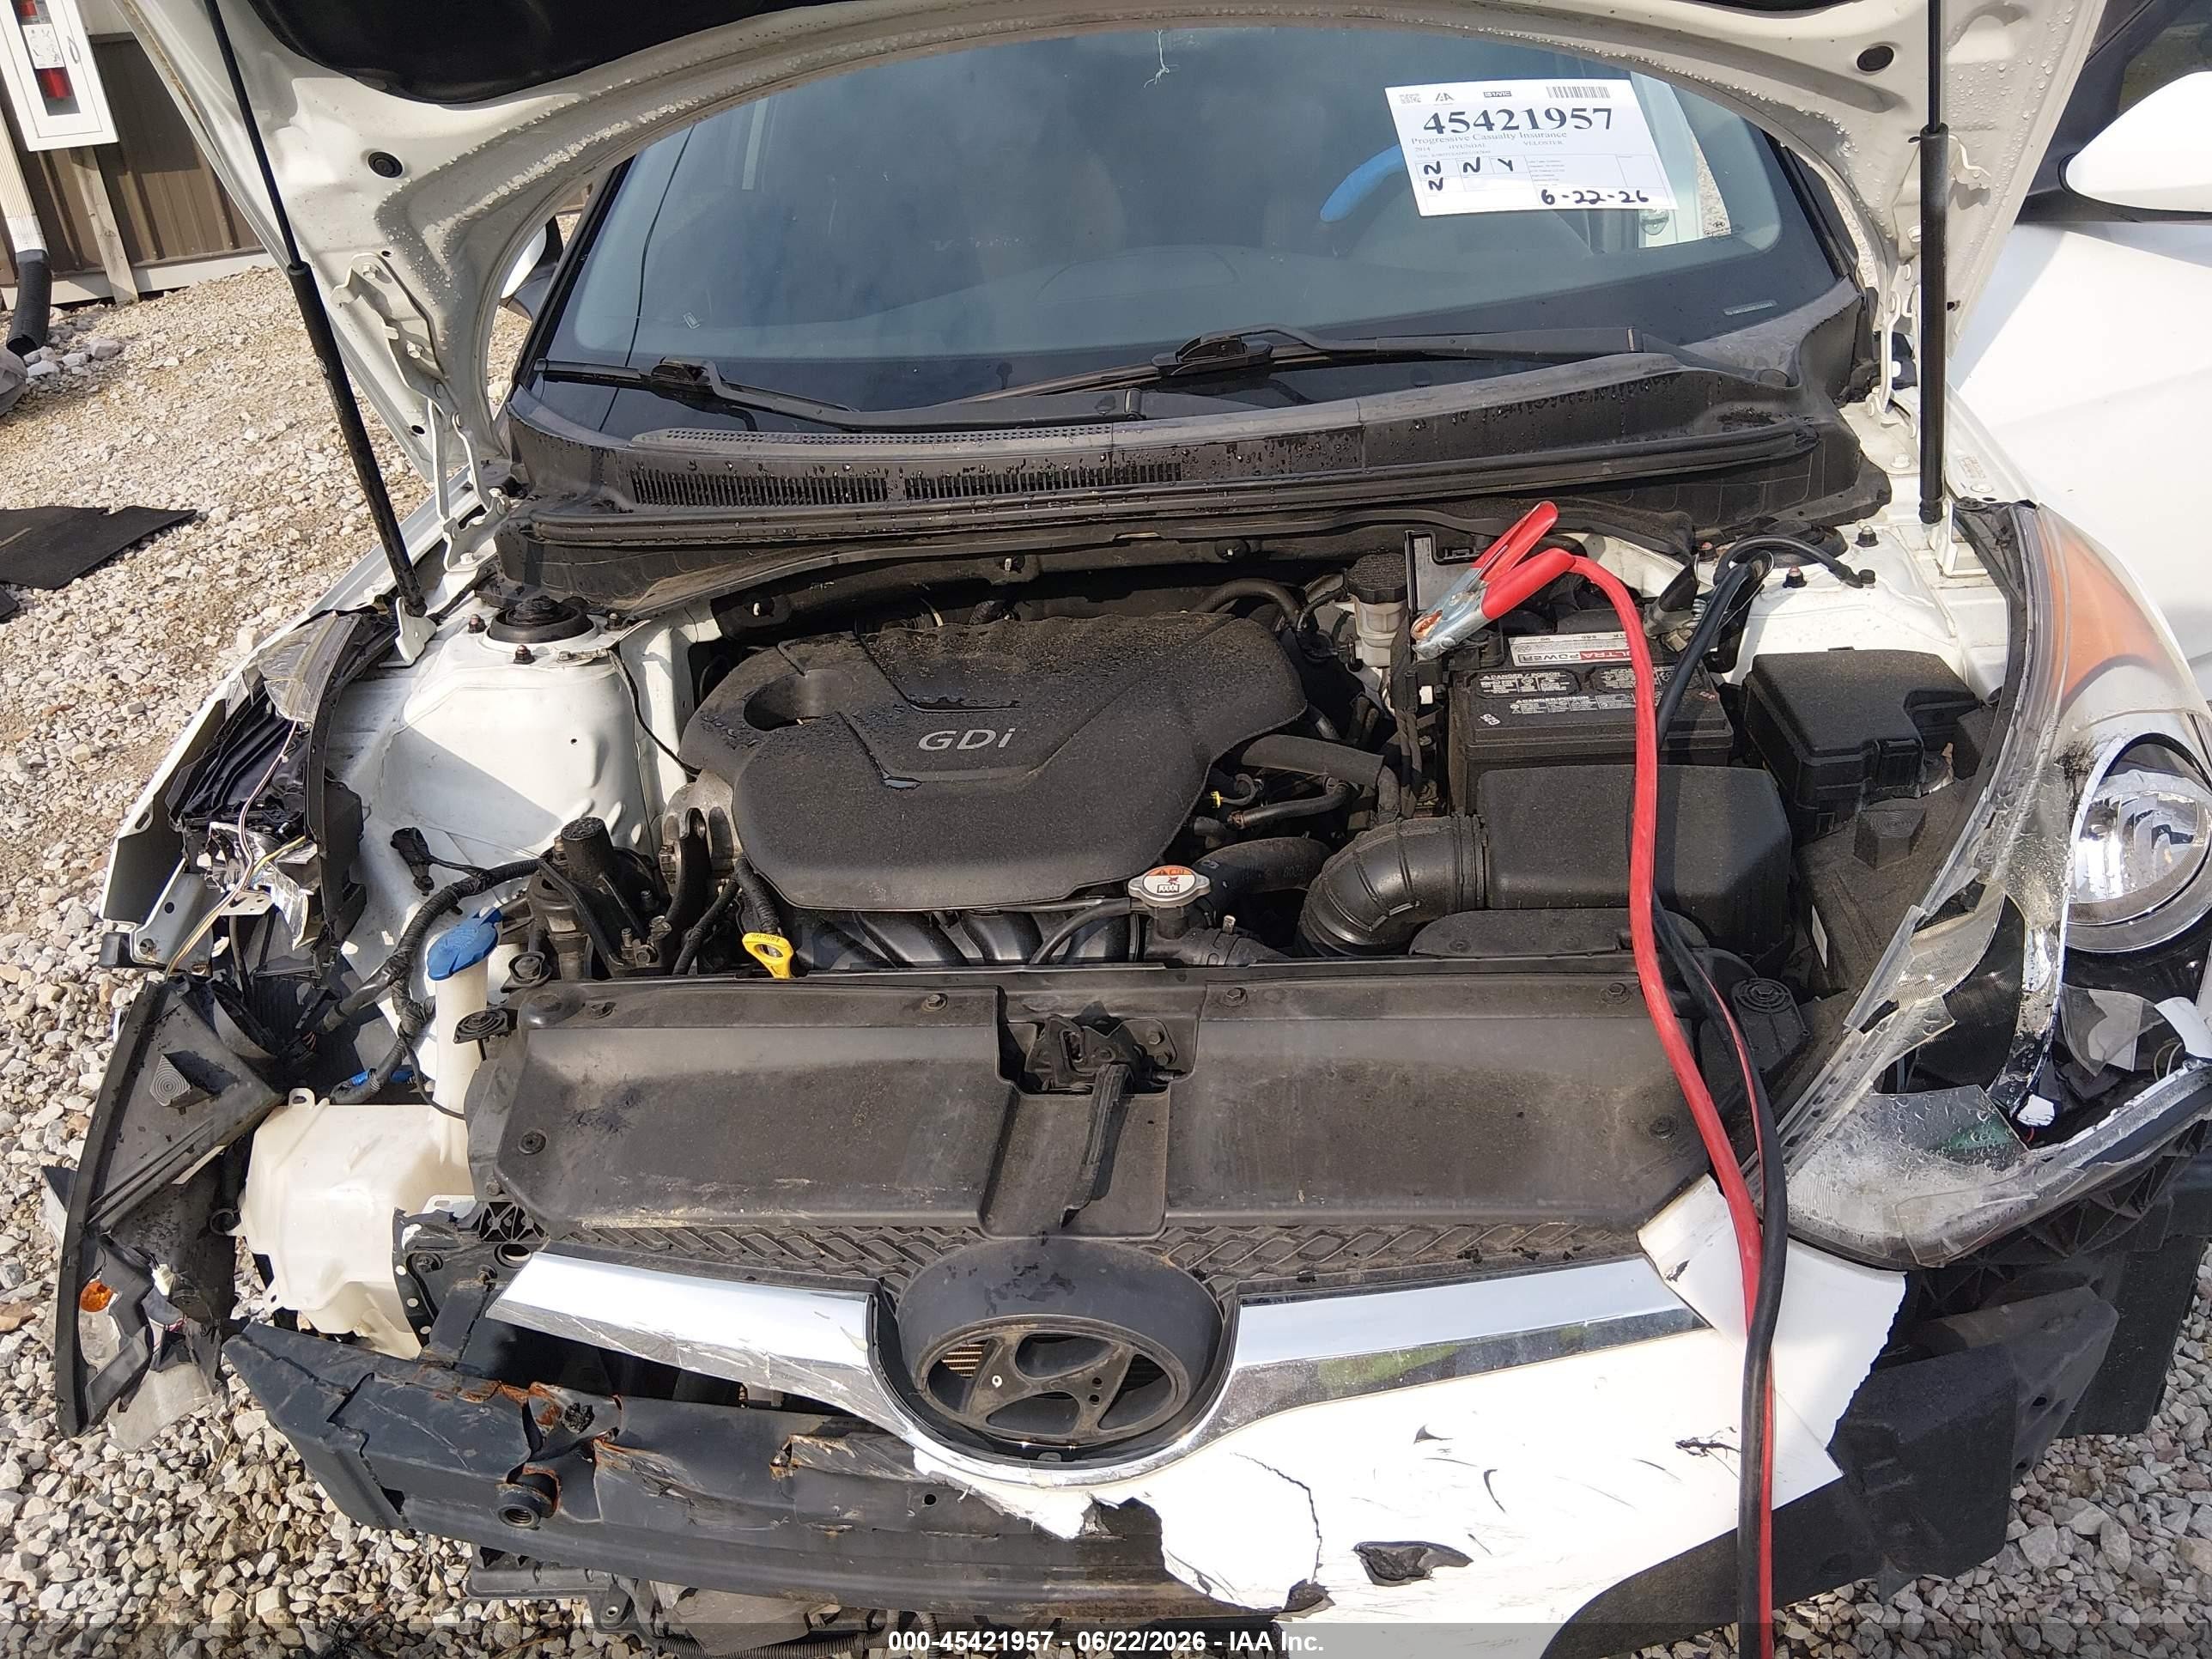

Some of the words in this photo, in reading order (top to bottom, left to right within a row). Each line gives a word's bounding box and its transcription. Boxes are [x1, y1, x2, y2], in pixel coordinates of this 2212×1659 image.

[1423, 107, 1612, 134] 45421957
[1411, 136, 1470, 147] Progressive
[1472, 131, 1516, 141] Casualty
[1519, 131, 1567, 140] Insurance
[1424, 161, 1442, 175] N
[1462, 156, 1481, 173] N
[1498, 158, 1514, 172] Y
[1429, 177, 1444, 191] N
[1541, 189, 1650, 205] 6-22-26
[1522, 653, 1579, 662] POWER
[1480, 714, 1501, 726] G25
[918, 728, 1017, 751] GDi
